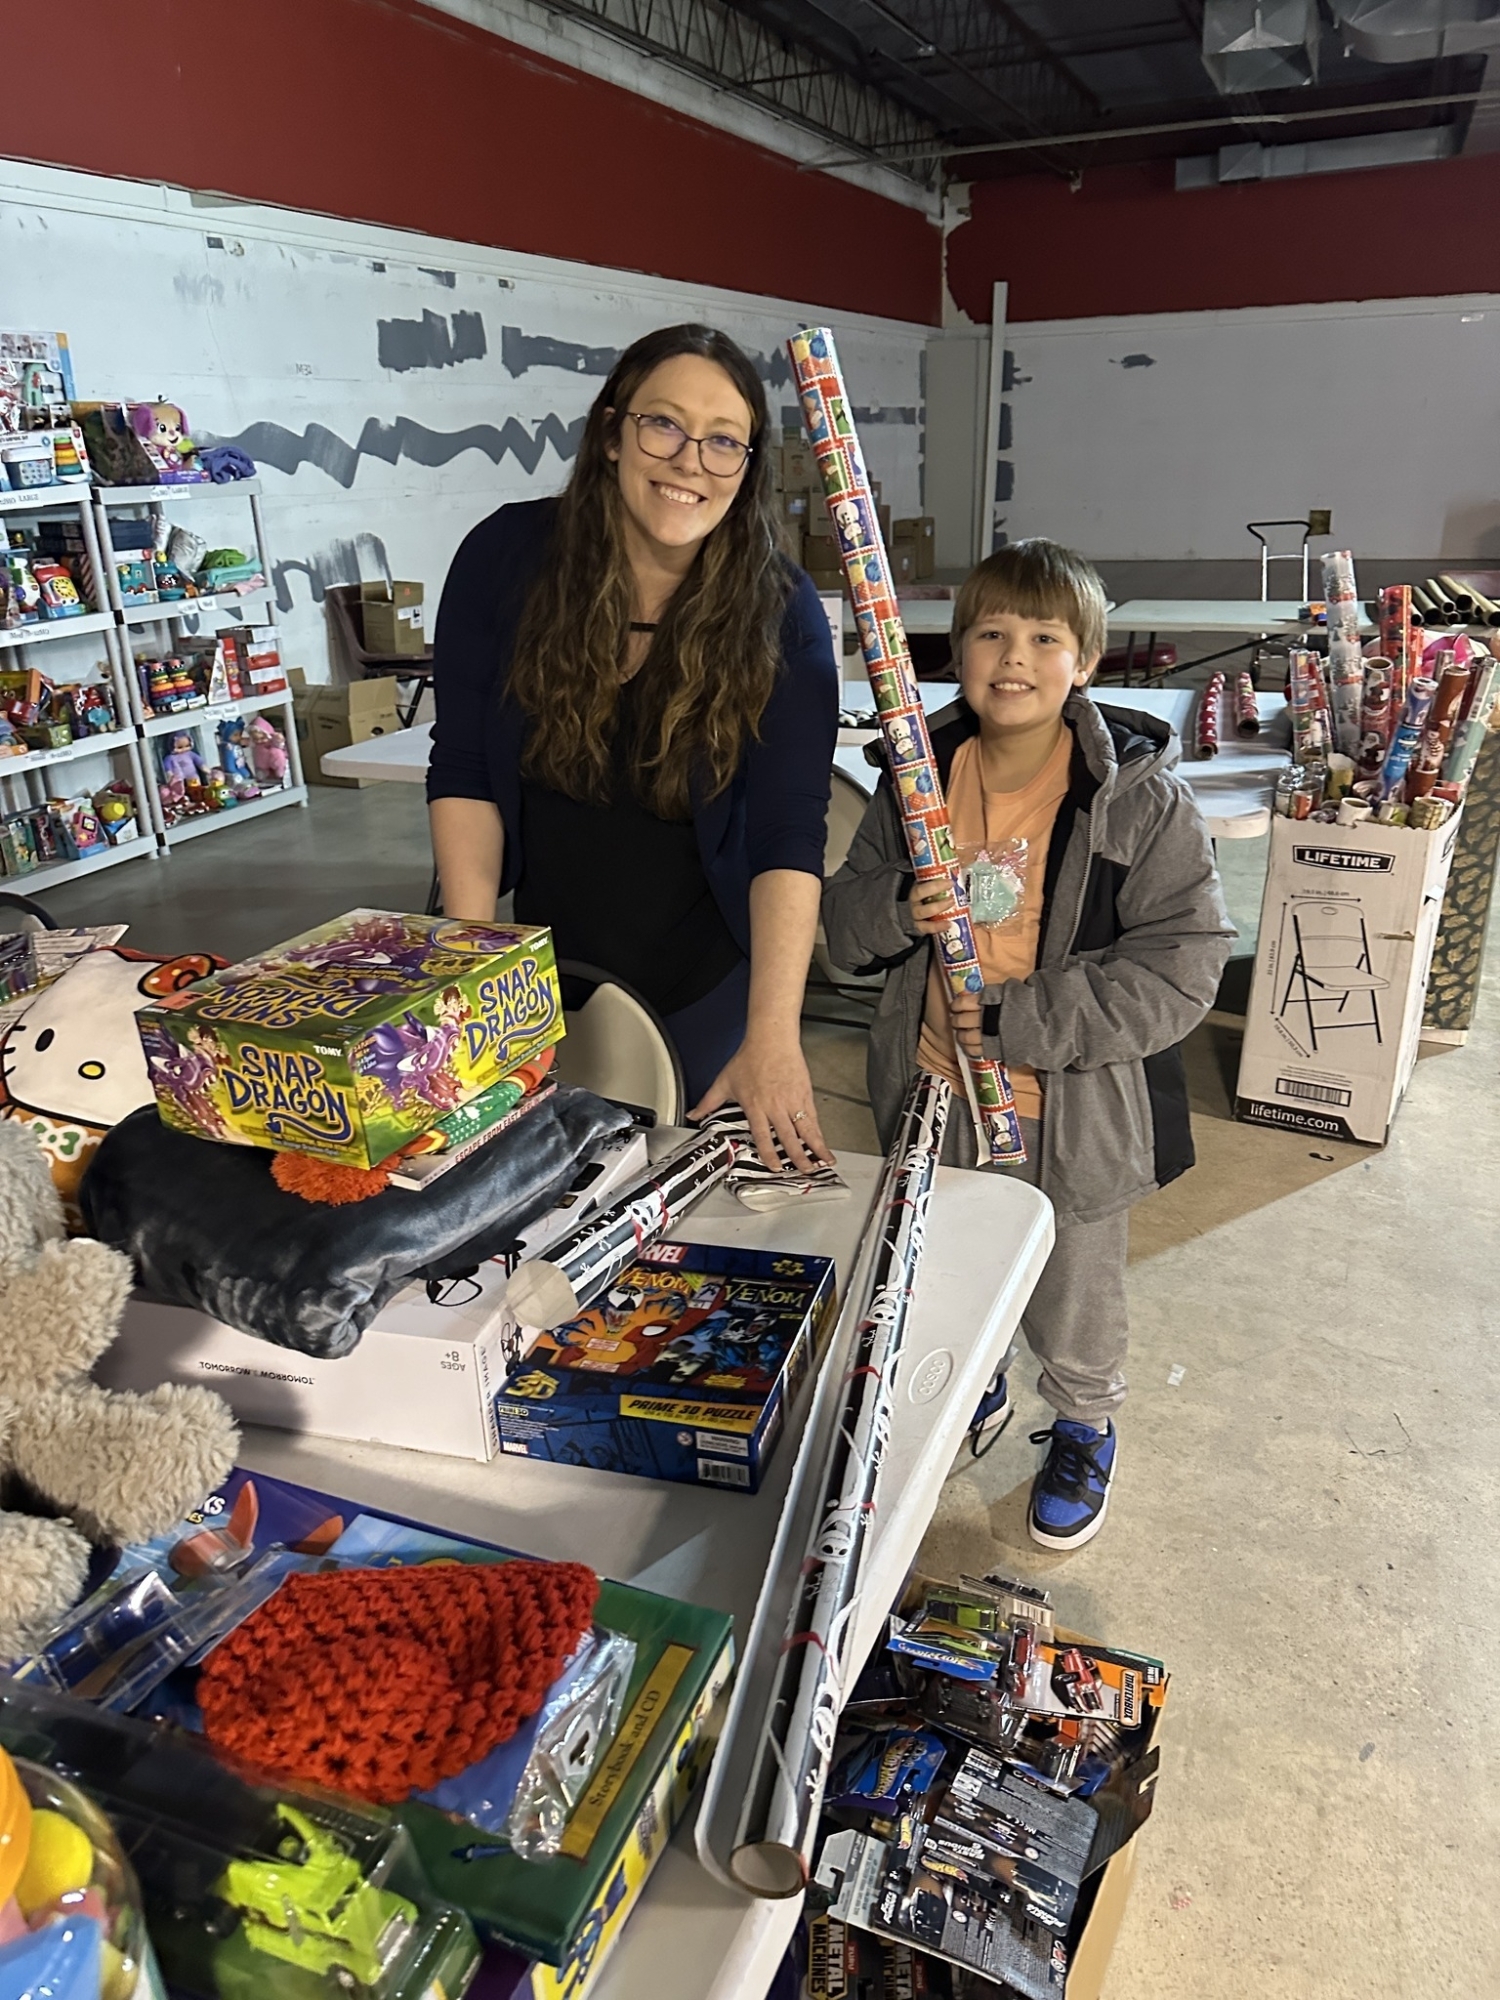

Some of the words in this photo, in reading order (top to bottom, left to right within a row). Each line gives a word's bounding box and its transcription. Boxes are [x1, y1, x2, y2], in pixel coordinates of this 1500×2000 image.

[1304, 850, 1382, 868] LIFETIME
[529, 937, 548, 953] TOMY
[204, 979, 382, 1019] DRAGON
[479, 957, 537, 1014] SNAP
[198, 1000, 301, 1028] SNAP
[464, 976, 555, 1068] DRAGON
[239, 1043, 324, 1089] SNAP
[313, 1045, 342, 1057] TOMY
[220, 1064, 353, 1132] DRAGON
[1250, 1103, 1339, 1132] lifetime.com
[455, 1139, 482, 1164] ESCAPE
[483, 1124, 502, 1143] FROM
[503, 1113, 518, 1130] EAST
[617, 1269, 692, 1294] VENOM
[725, 1282, 806, 1308] VENOM
[441, 1360, 466, 1371] AGES
[445, 1350, 460, 1361] 8+
[480, 1347, 490, 1387] IMAGE
[919, 1360, 946, 1396] COSCO
[486, 1392, 498, 1447] SHARPER
[628, 1400, 679, 1413] PRIME
[679, 1405, 702, 1415] 3D
[702, 1407, 757, 1421] PUZZLE
[1124, 1673, 1135, 1721] MATCHBOX
[588, 1741, 634, 1807] Storybook
[631, 1714, 649, 1739] and
[641, 1690, 660, 1712] CD
[811, 1924, 828, 1994] MACHINES
[828, 1923, 844, 1996] METAL
